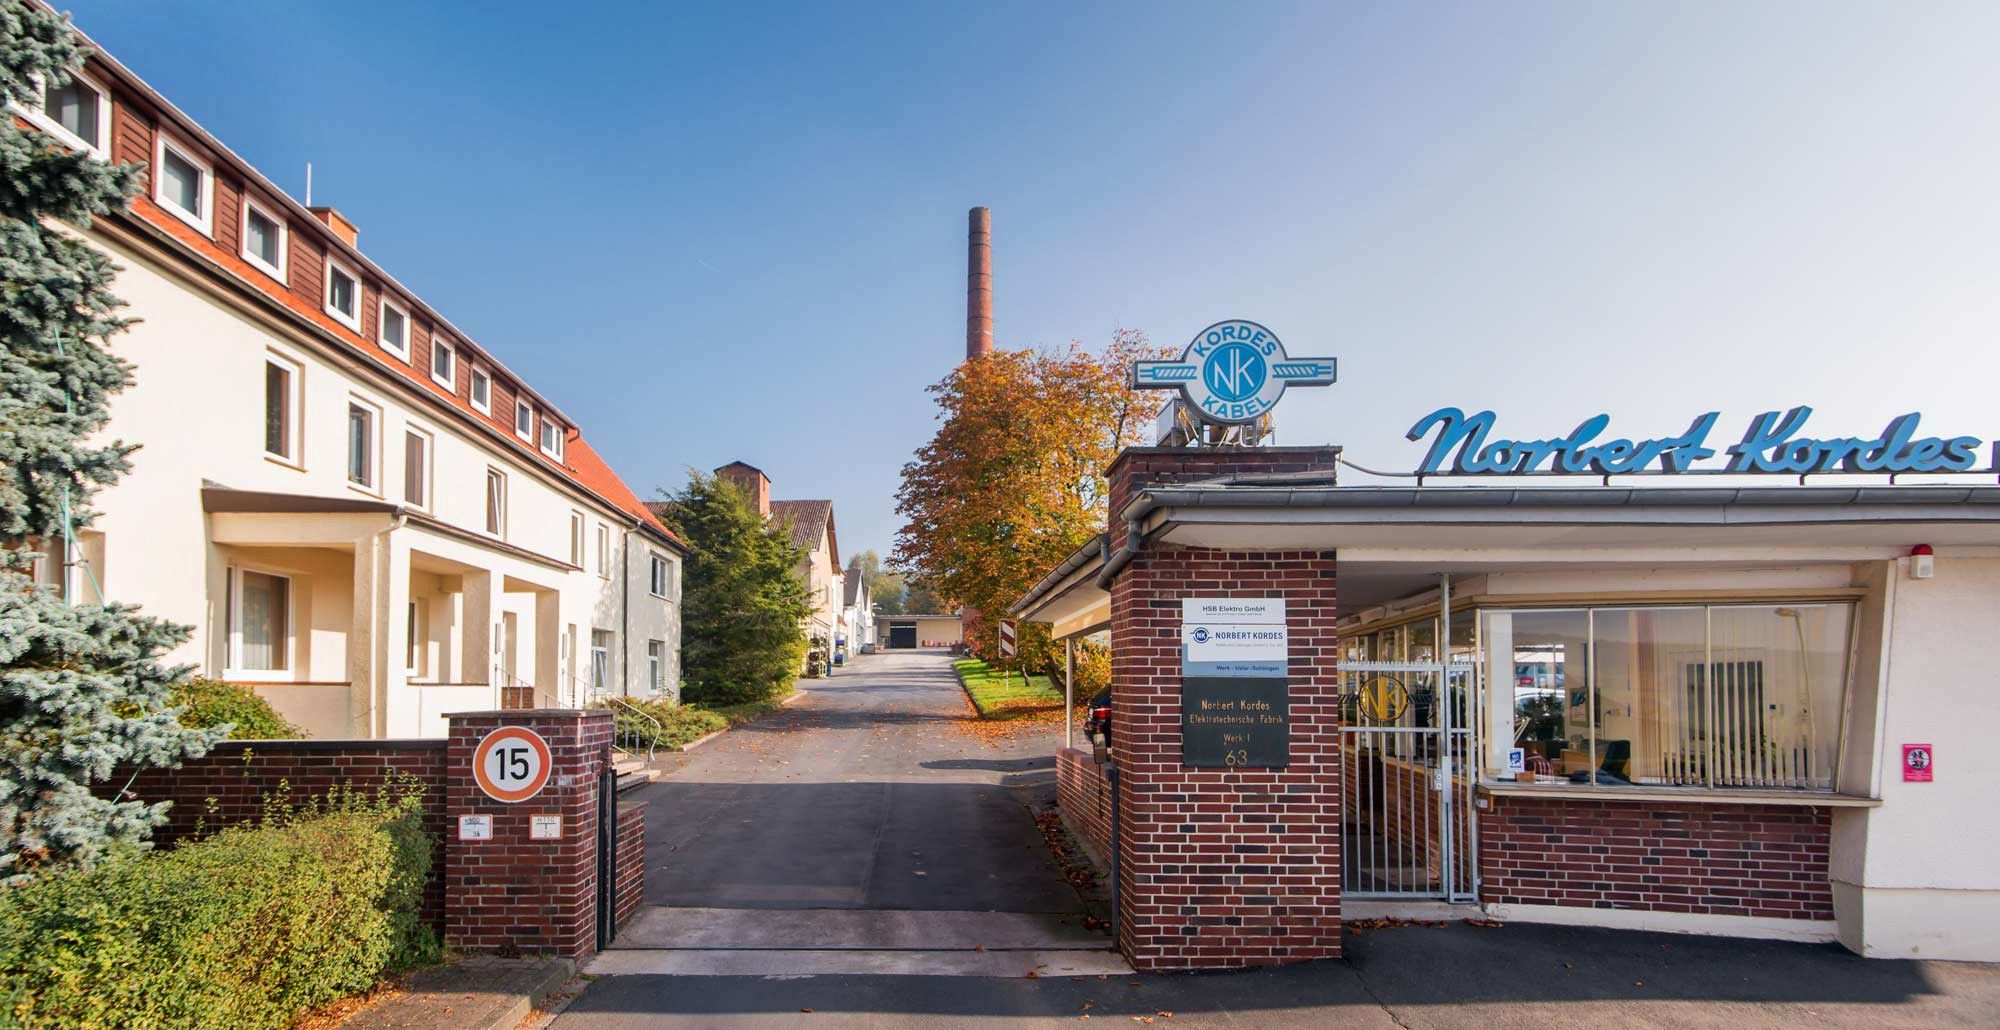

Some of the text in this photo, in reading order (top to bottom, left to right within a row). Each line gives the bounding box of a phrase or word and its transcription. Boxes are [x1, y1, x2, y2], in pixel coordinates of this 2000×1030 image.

[1193, 325, 1277, 358] KORDES
[1213, 348, 1255, 396] NK
[1201, 396, 1272, 419] KABEL
[1405, 406, 1720, 474] Norbert
[1725, 404, 1984, 474] Kordes
[1215, 632, 1284, 640] NORBERT KORDES
[1201, 699, 1270, 711] Norbert Kordes
[1260, 714, 1283, 724] Fabrik
[1223, 733, 1242, 743] Werk
[495, 748, 530, 780] 15
[1225, 749, 1248, 766] 63
